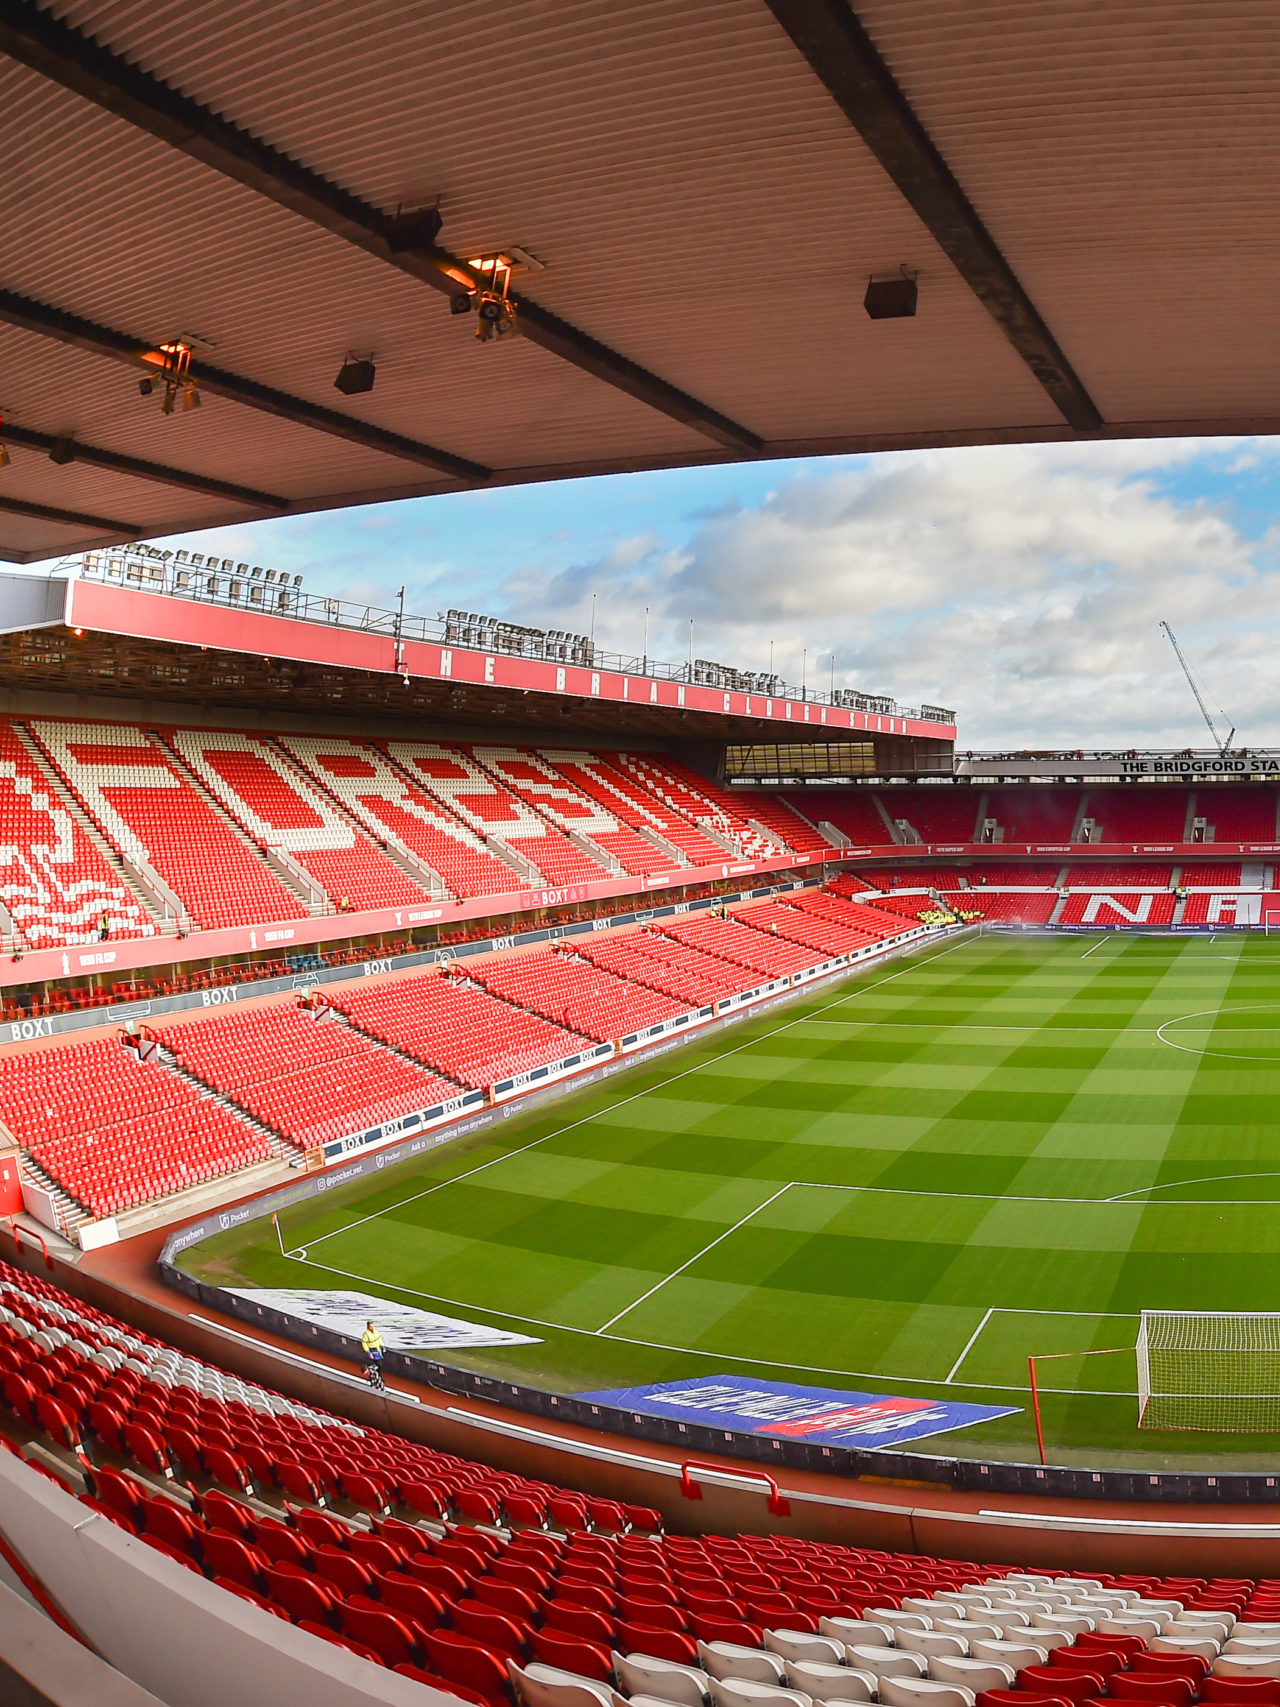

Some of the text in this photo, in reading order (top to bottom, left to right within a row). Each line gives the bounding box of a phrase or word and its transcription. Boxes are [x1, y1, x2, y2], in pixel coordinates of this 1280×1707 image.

[393, 641, 496, 682] THE
[556, 667, 686, 706] BRIAN
[723, 692, 827, 724] CLOUGH
[1121, 762, 1149, 773] THE
[1153, 760, 1246, 773] BRIDGFORD
[541, 889, 569, 905] BOXT
[592, 916, 612, 931] BOXT
[492, 936, 516, 951] BOXT
[363, 957, 394, 976] BOXT
[200, 986, 238, 1006] BOXT
[11, 1017, 54, 1041] BOXT
[442, 1099, 465, 1116] BOXT
[380, 1119, 404, 1137] BOXT
[340, 1136, 367, 1154] BOXT
[326, 1165, 365, 1188] @pocket.vet
[229, 1209, 251, 1224] Pocket
[174, 1225, 206, 1249] anywhere
